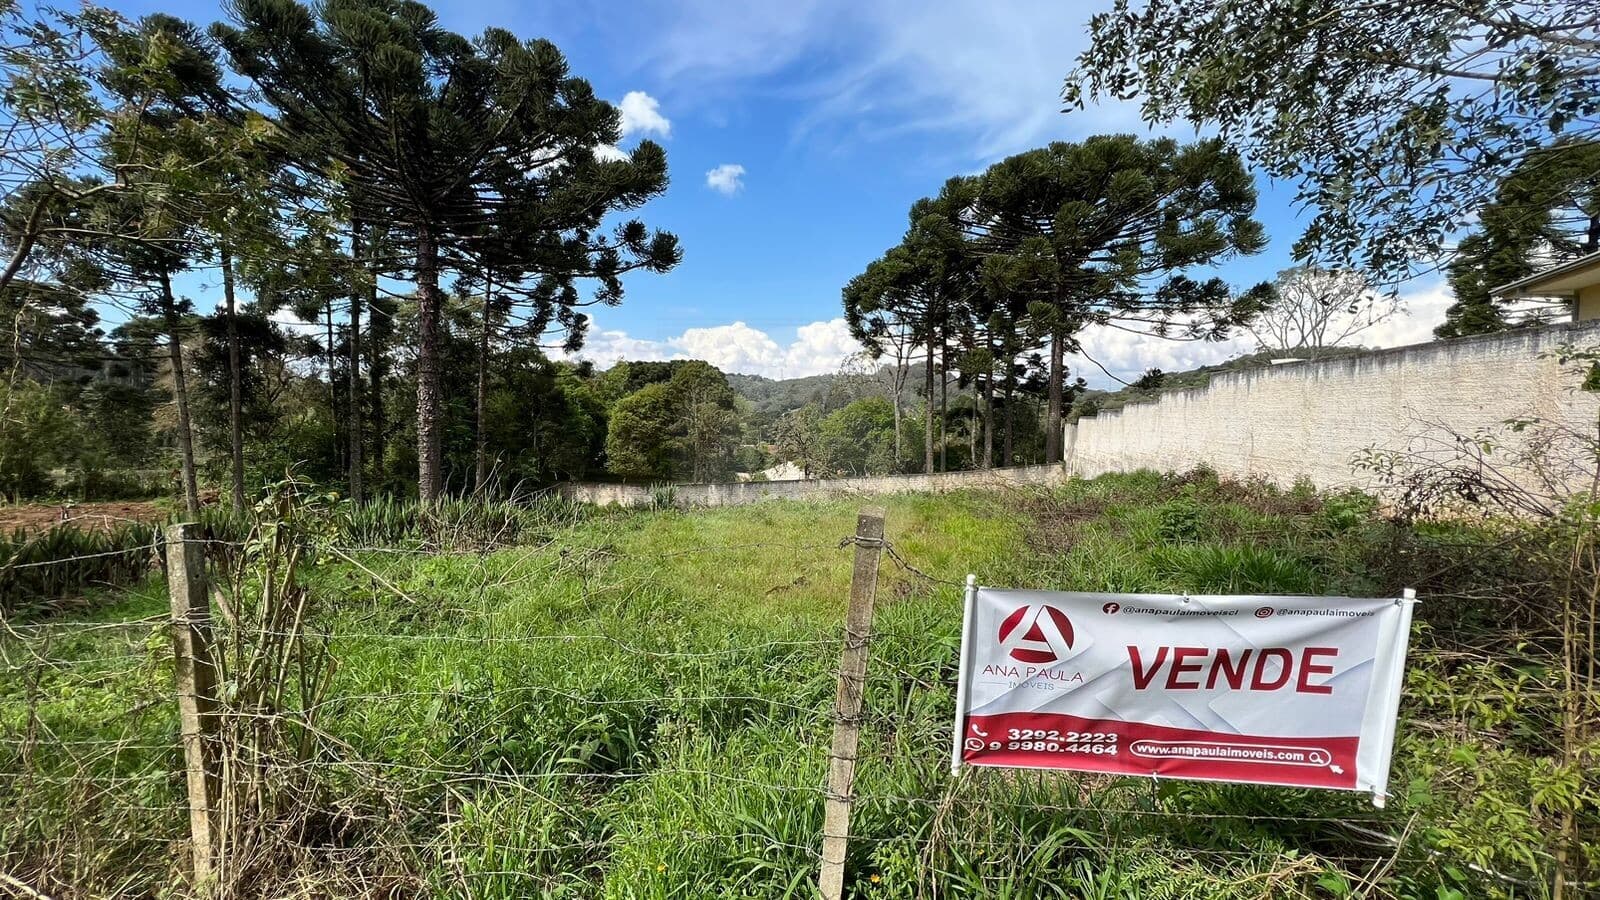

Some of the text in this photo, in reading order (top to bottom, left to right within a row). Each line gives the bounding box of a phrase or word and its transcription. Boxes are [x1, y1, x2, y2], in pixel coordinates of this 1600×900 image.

[982, 664, 1084, 683] ANA PAULA
[1127, 645, 1339, 695] VENDE
[1008, 728, 1118, 743] 3292.2223
[989, 741, 1118, 756] 9 9980.4464
[1136, 744, 1304, 761] www.anapaulaimoveis.com
